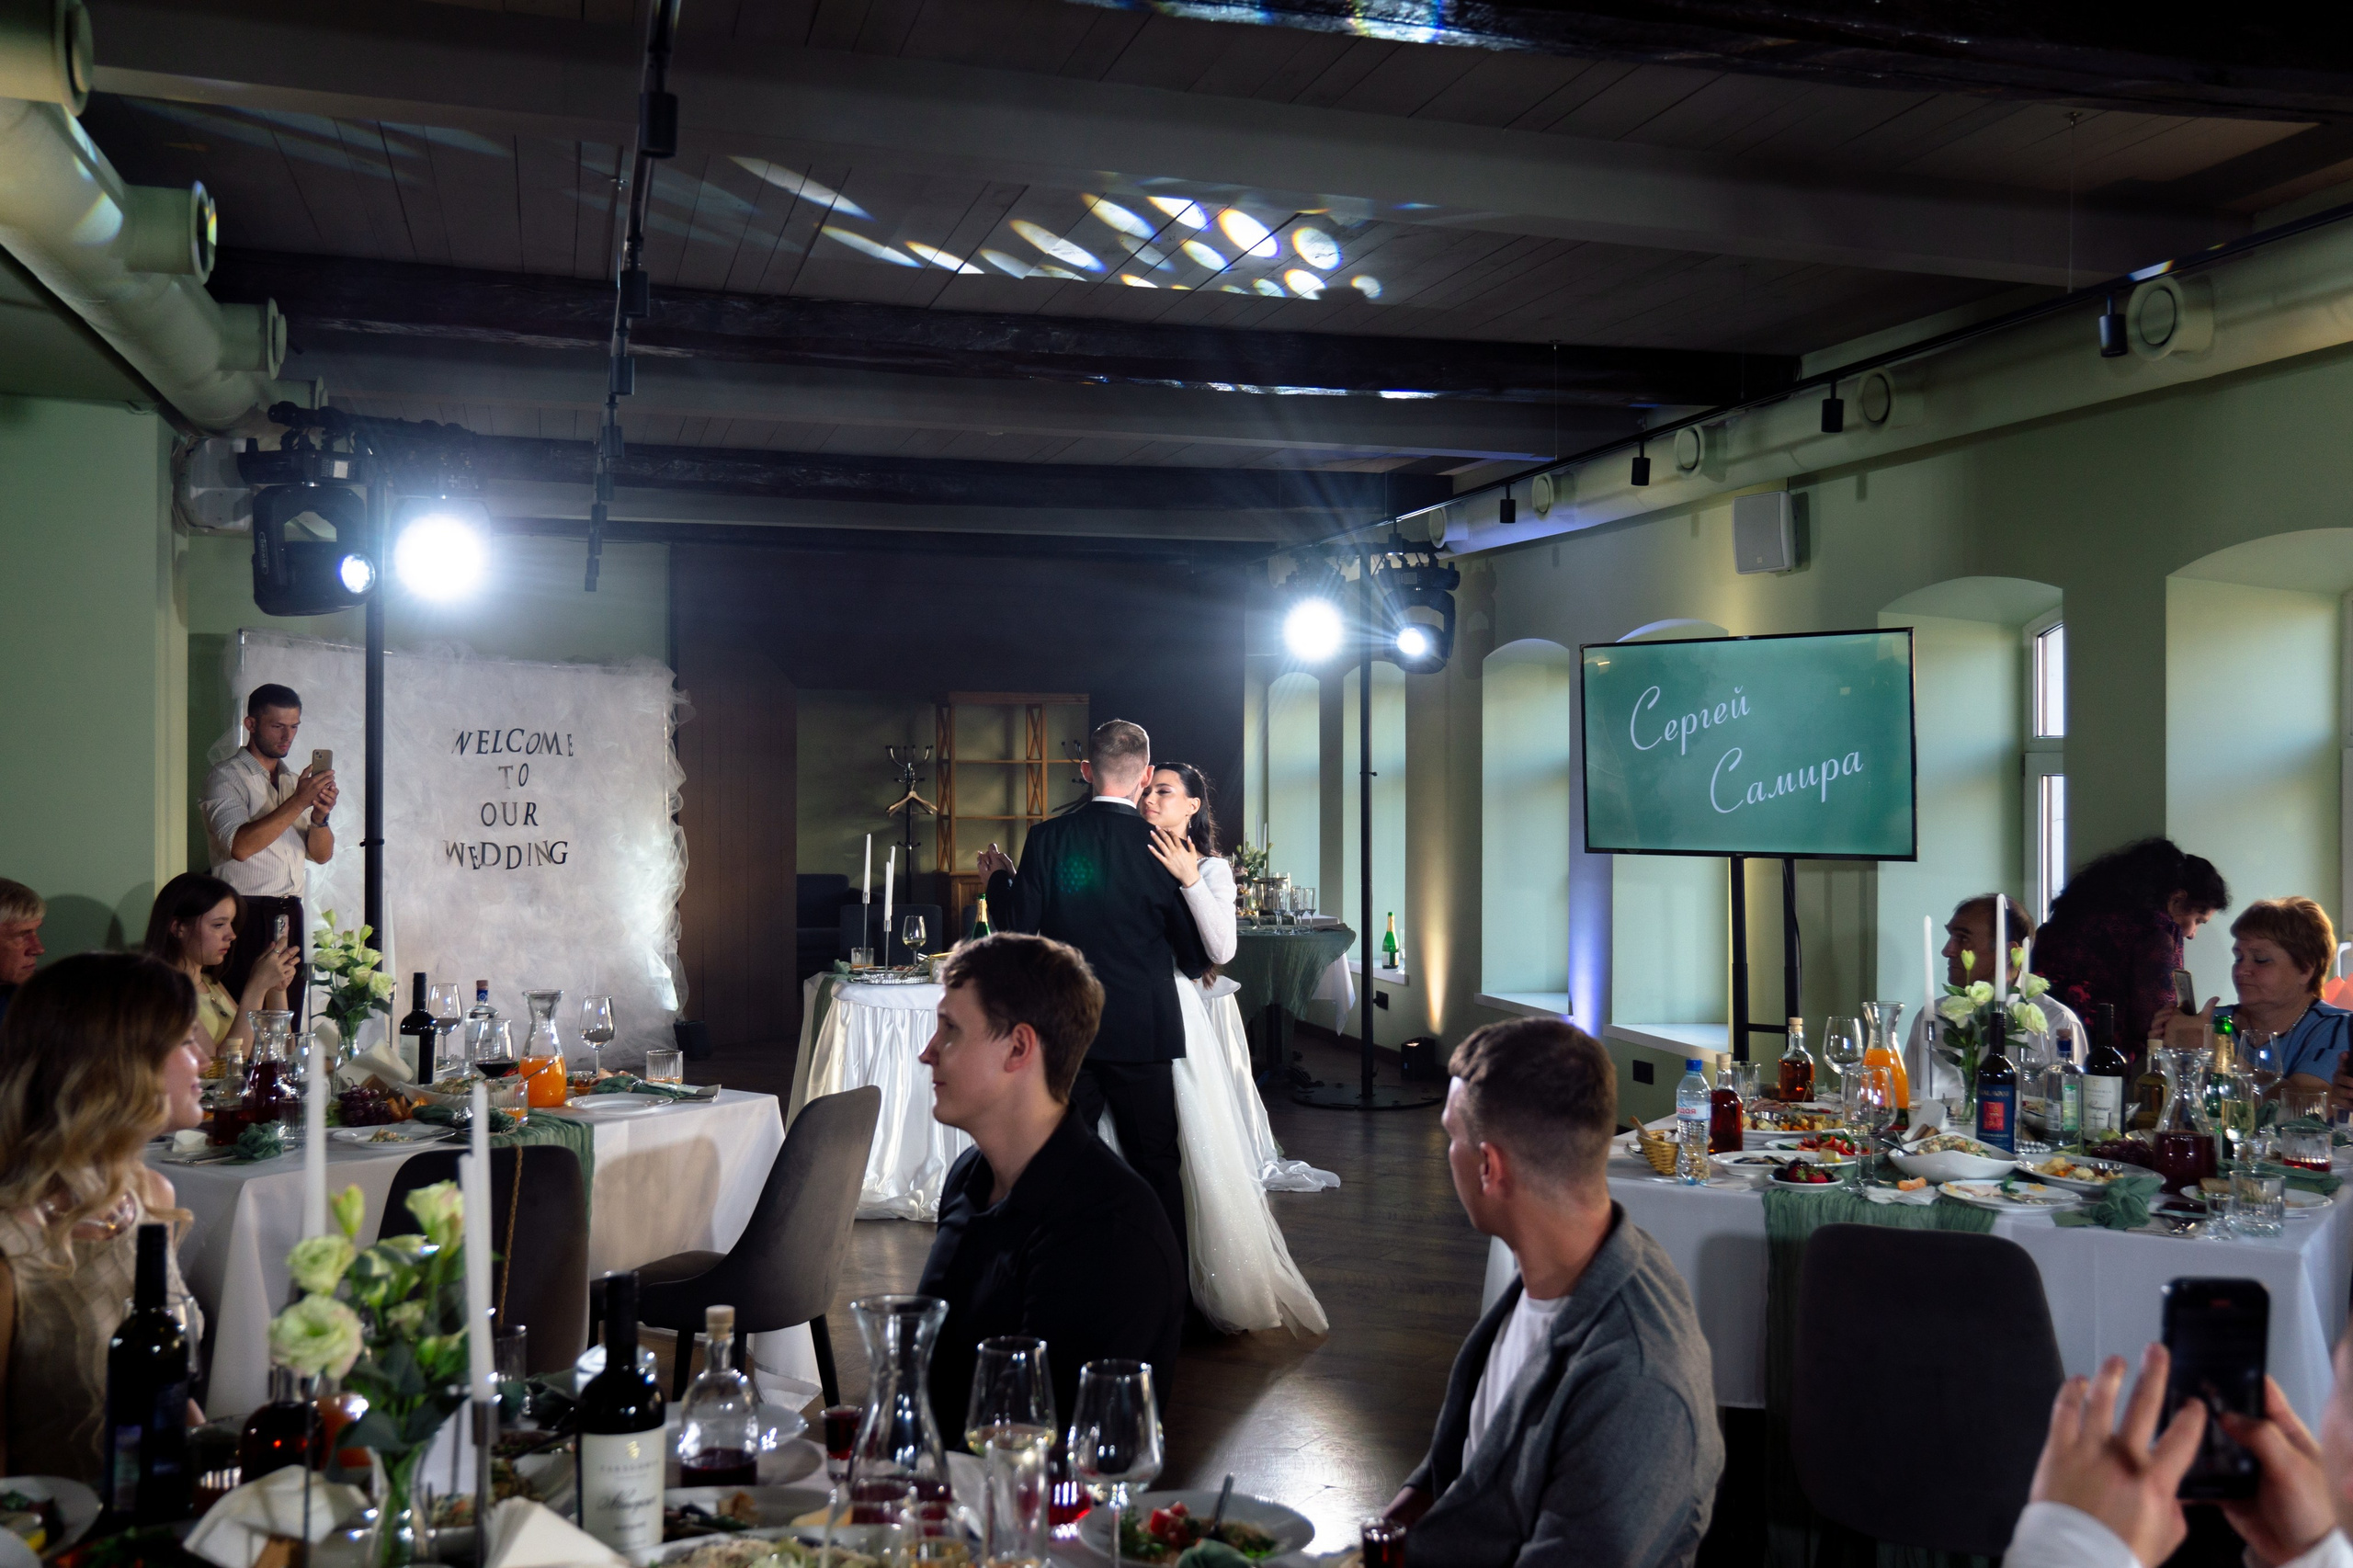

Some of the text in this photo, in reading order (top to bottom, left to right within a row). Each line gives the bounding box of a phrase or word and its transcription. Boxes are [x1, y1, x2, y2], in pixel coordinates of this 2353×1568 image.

[1630, 685, 1751, 756] Сергей
[451, 728, 574, 757] WELCOME
[498, 762, 529, 790] TO
[1710, 747, 1864, 814] Самира
[481, 801, 539, 827] OUR
[443, 840, 569, 870] WEDDING
